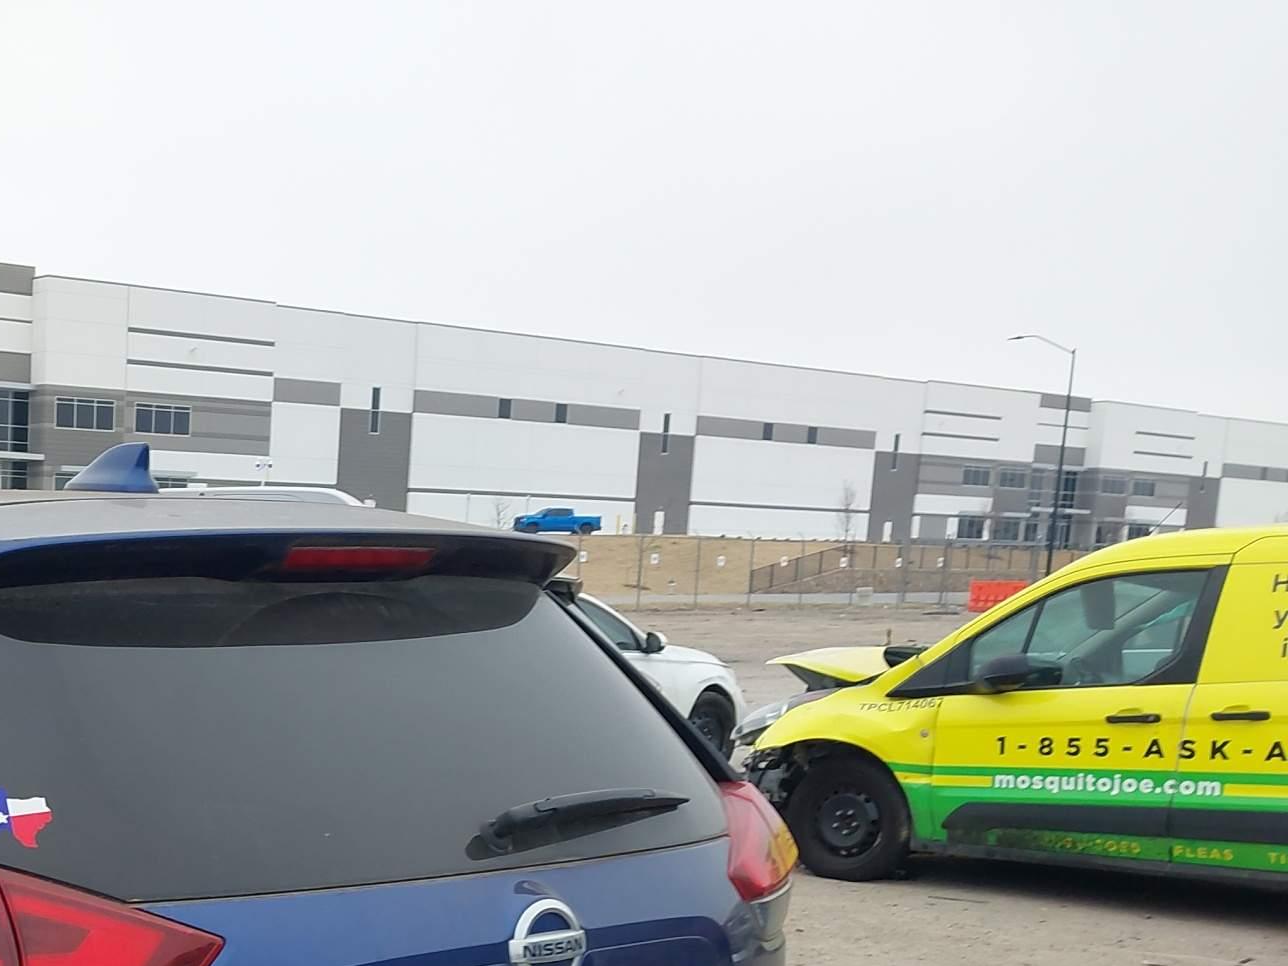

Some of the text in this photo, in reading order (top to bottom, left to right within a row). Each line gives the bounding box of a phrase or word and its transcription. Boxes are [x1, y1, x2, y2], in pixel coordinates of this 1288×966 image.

[993, 773, 1222, 797] mosquitojoe.com
[1172, 845, 1234, 861] FLEAS
[523, 938, 583, 958] NISSAN
